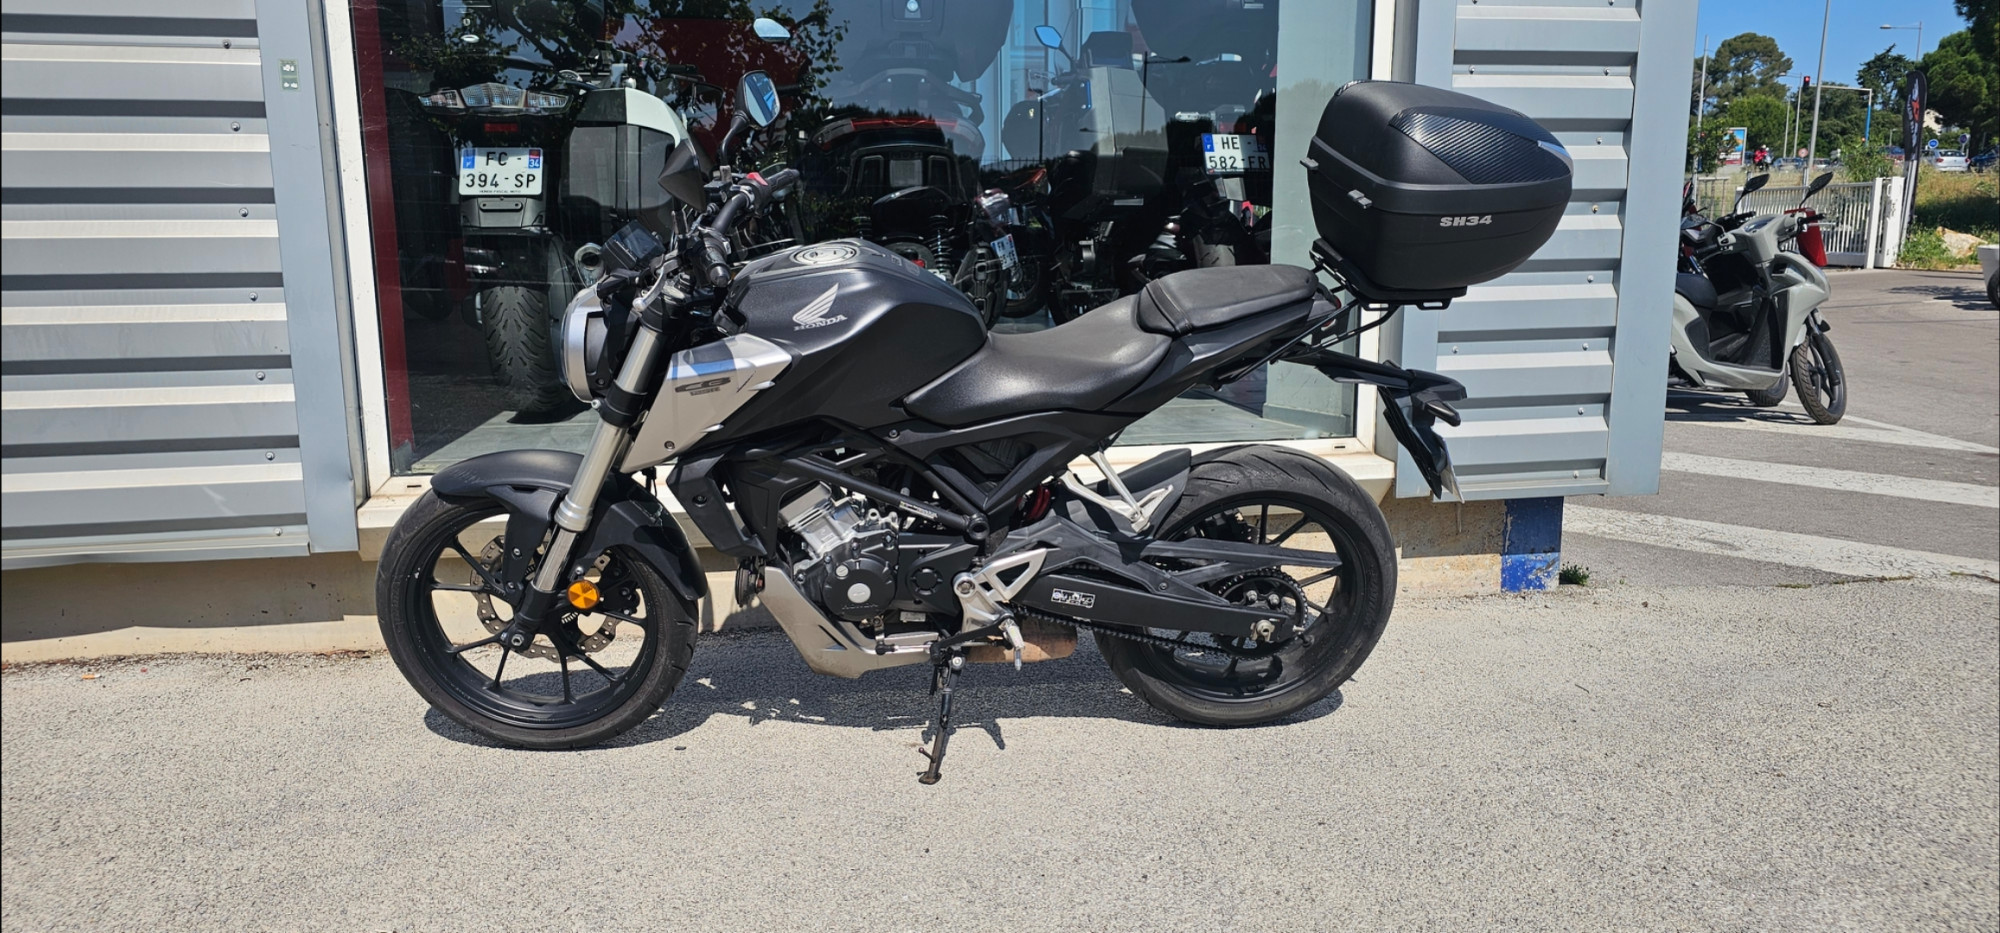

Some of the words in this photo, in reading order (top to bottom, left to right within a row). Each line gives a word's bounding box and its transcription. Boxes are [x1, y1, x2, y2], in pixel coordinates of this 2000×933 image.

[1221, 136, 1240, 149] HE
[485, 151, 508, 166] FC
[529, 159, 540, 168] 34
[1439, 214, 1493, 227] SH34
[793, 314, 848, 331] HONDA
